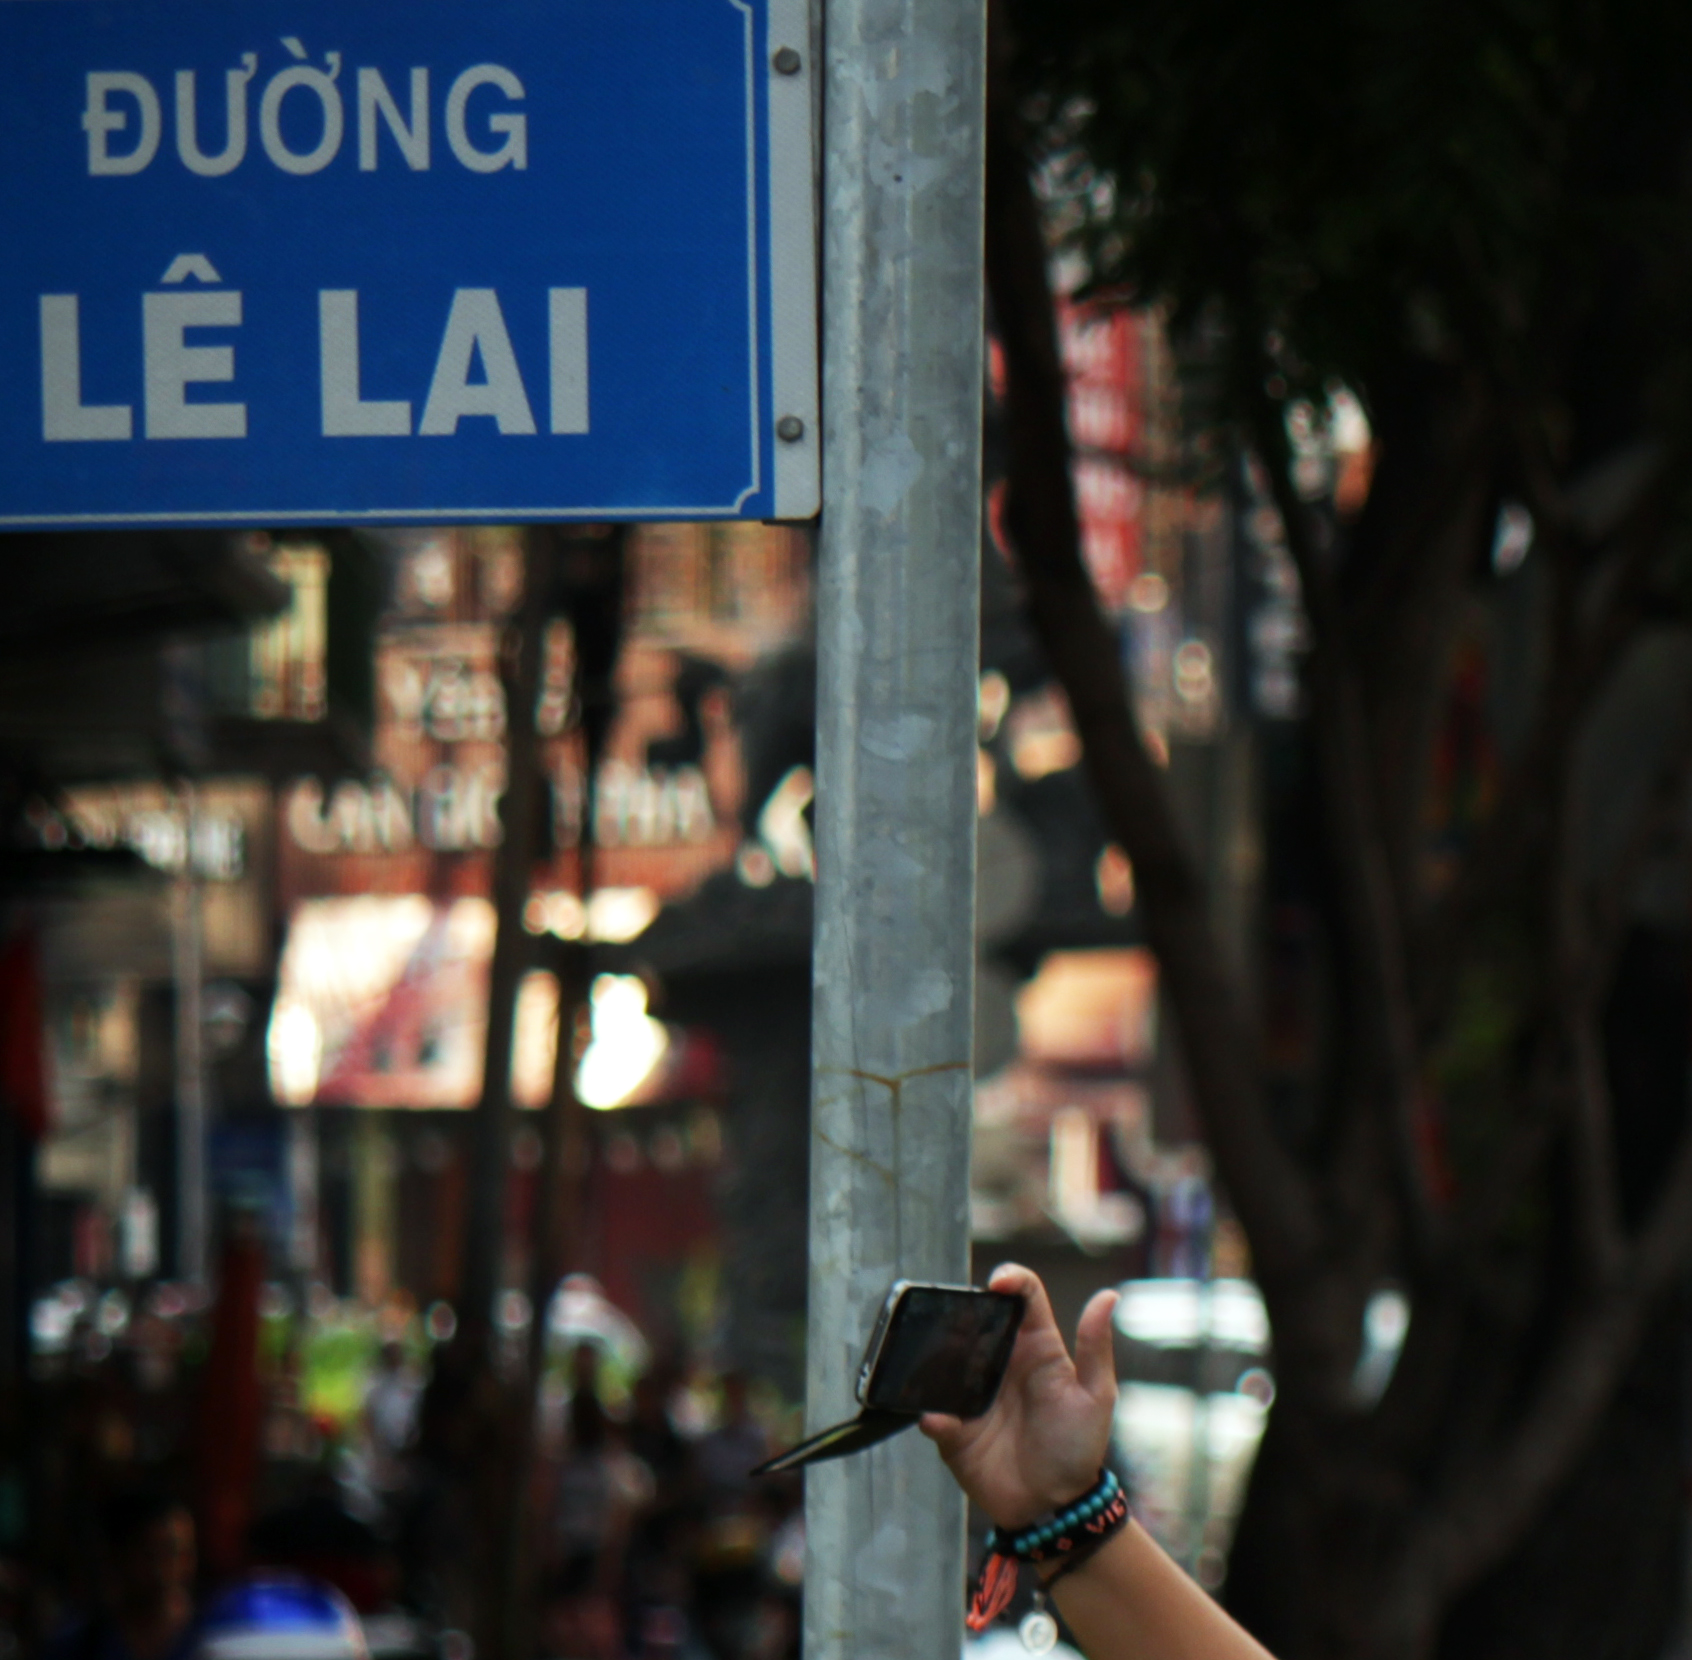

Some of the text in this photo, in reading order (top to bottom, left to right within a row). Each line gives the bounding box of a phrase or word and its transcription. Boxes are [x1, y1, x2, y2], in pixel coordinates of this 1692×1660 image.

[81, 37, 528, 176] ĐƯỜNG
[39, 253, 590, 442] LÊ LAI
